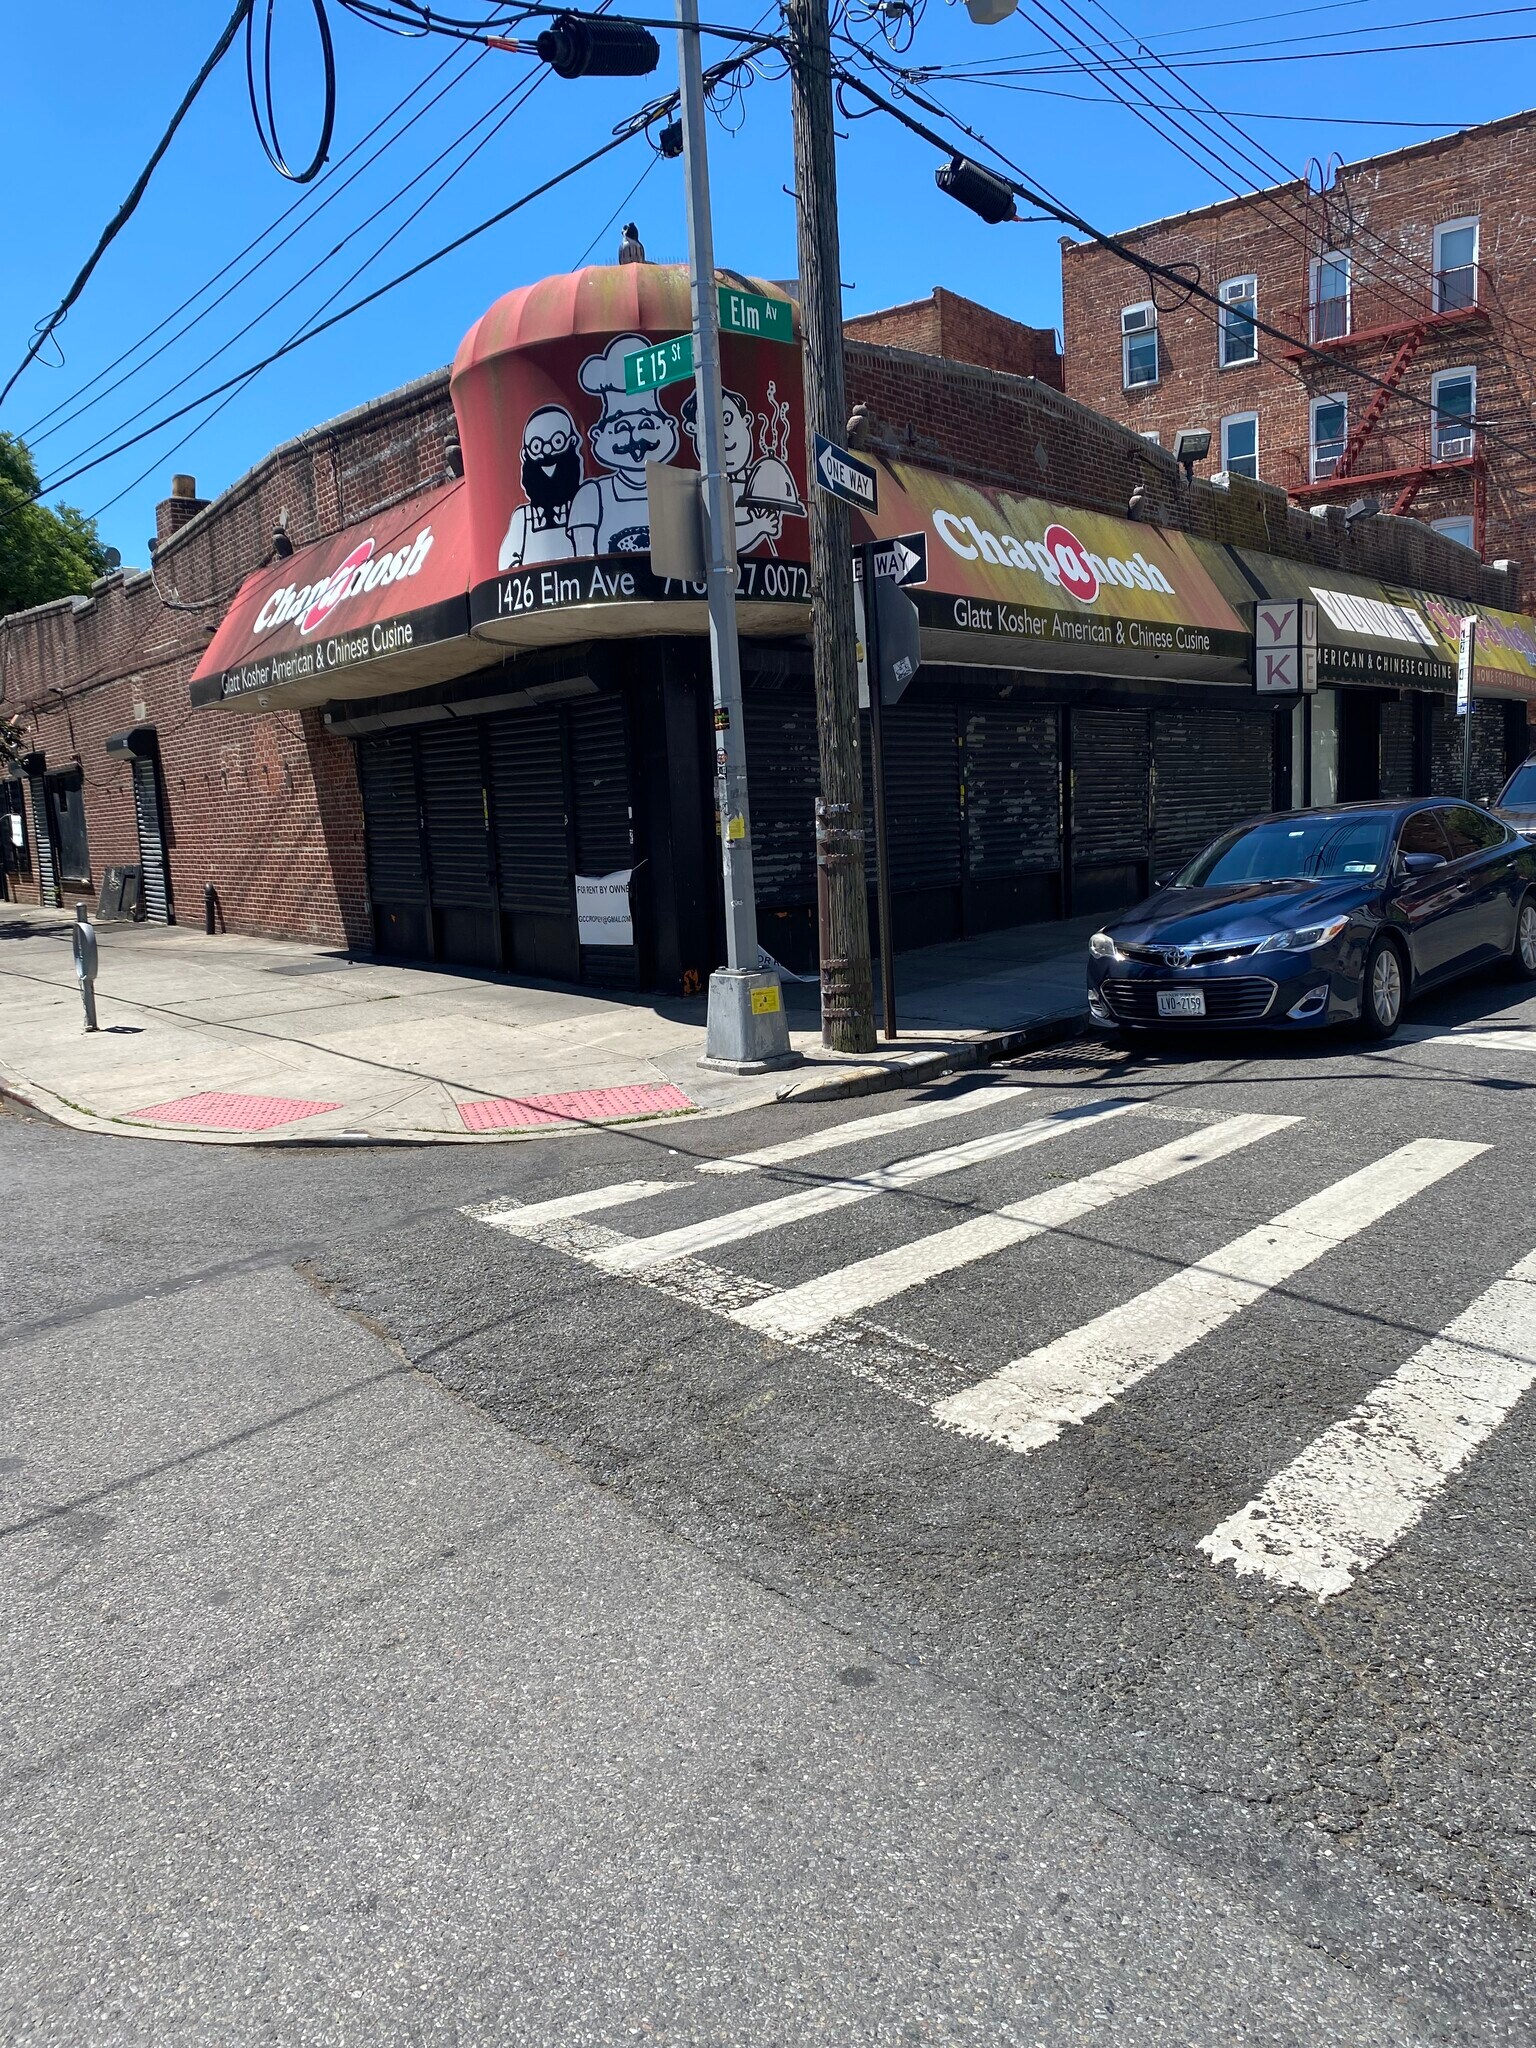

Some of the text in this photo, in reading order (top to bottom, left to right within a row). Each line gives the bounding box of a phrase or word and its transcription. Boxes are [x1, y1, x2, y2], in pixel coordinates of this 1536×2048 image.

[730, 295, 777, 331] Elm Av
[636, 342, 681, 387] E 15 St
[826, 456, 869, 496] ONE WAY
[876, 551, 909, 575] WAY
[498, 565, 635, 614] 1426 Elm Ave
[953, 598, 1210, 650] Glatt Kosher American & Chinese Cusine
[221, 621, 412, 694] Glatt Kosher American & Chinese Cusine
[1367, 654, 1374, 669] &
[1376, 655, 1415, 675] CHINESE
[1418, 660, 1451, 680] CUISINE
[599, 885, 608, 894] BY
[609, 884, 629, 894] OWNE
